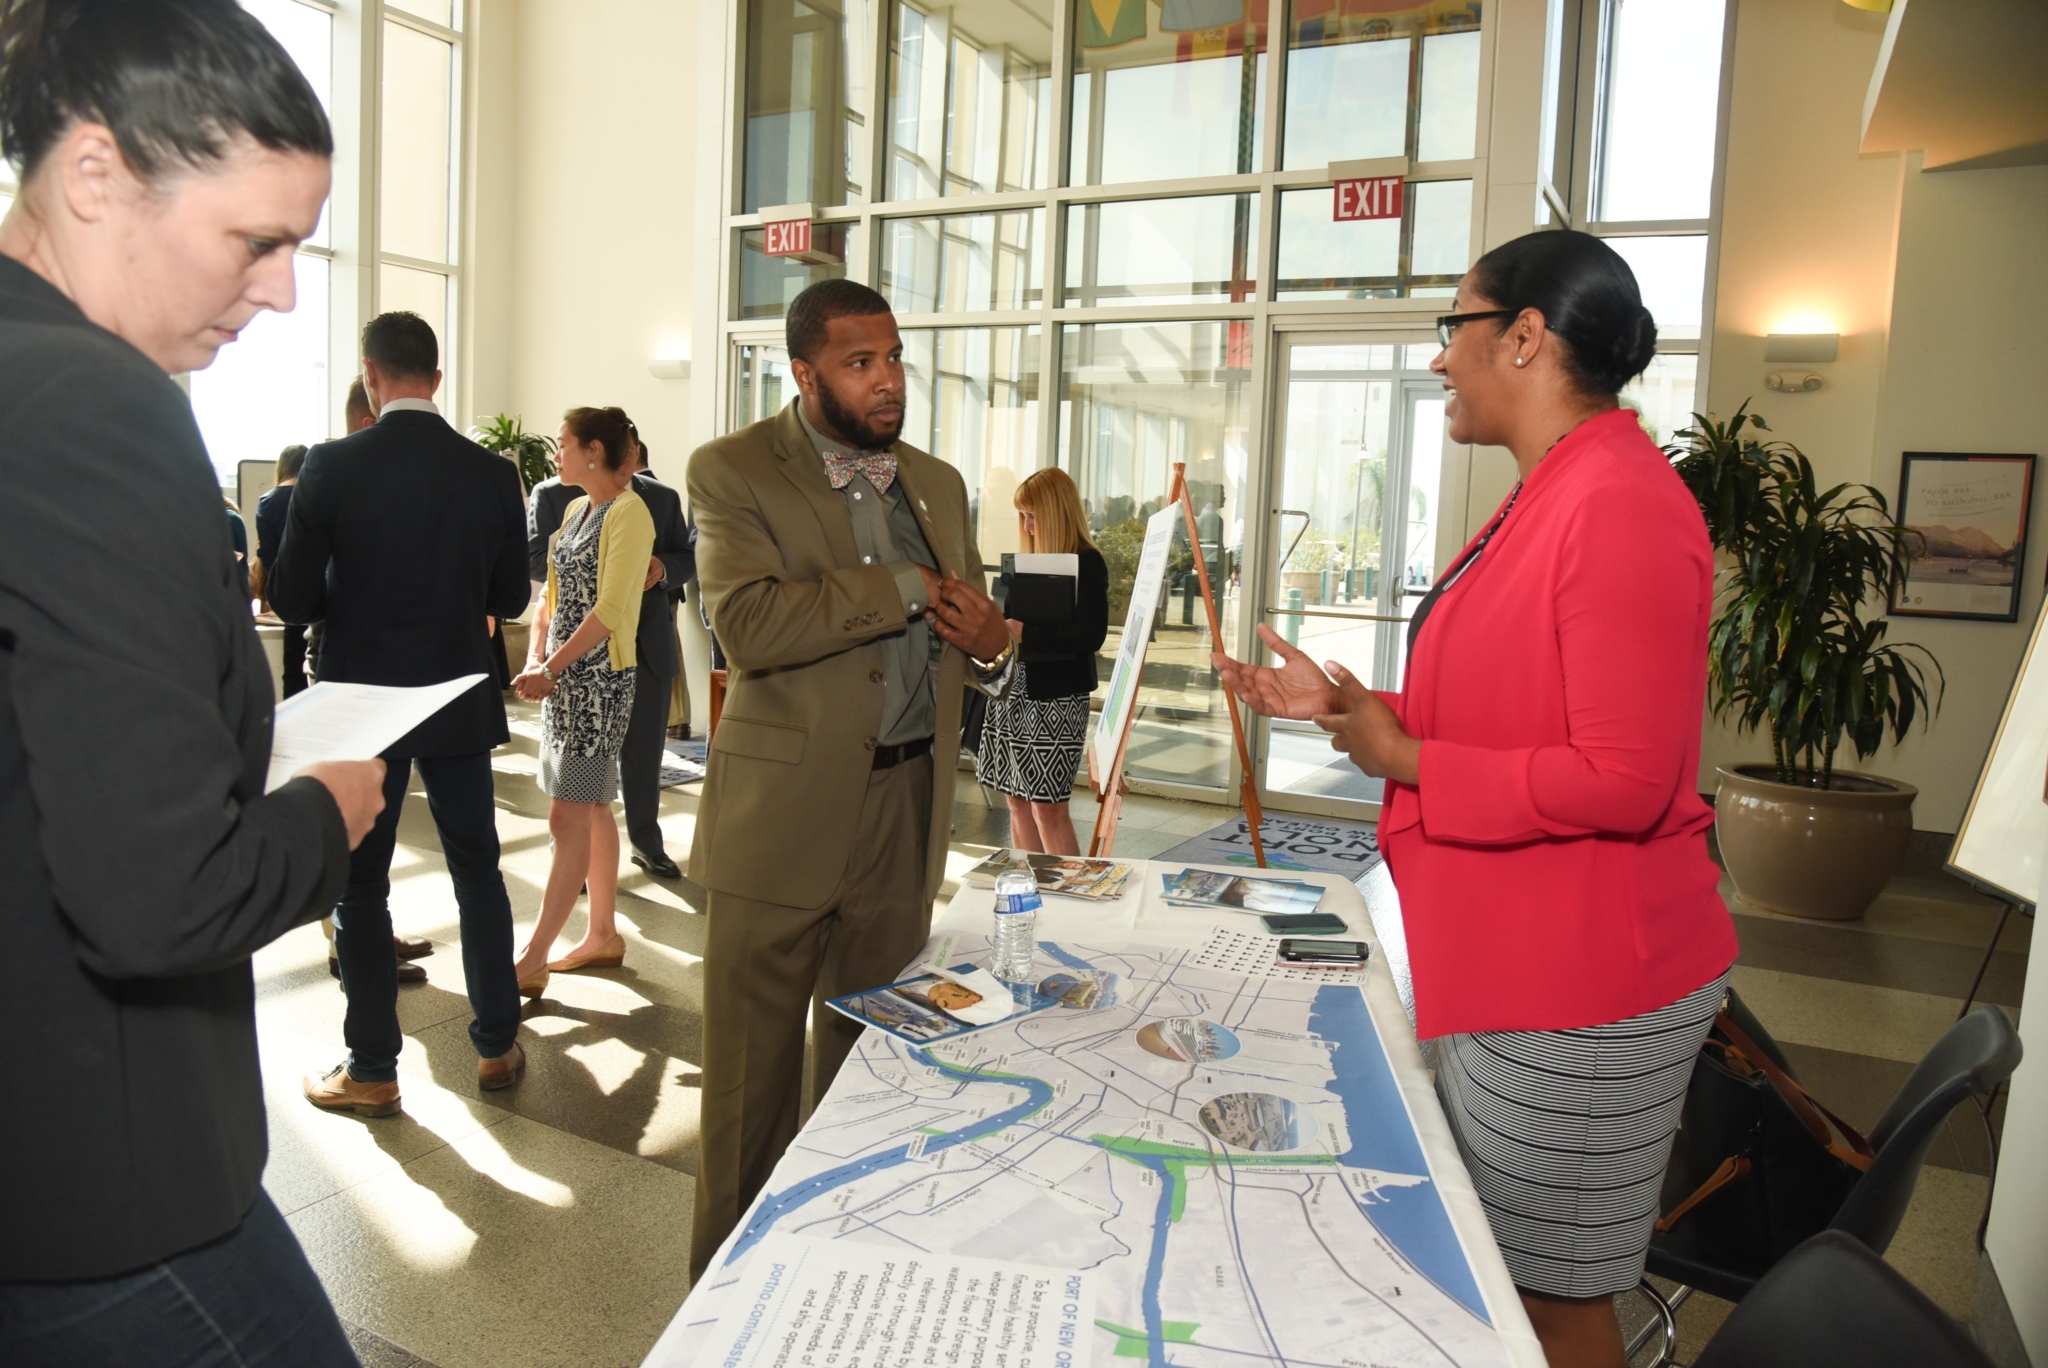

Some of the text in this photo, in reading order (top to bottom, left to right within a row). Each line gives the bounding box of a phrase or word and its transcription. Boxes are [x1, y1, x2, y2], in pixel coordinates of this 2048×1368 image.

[1338, 179, 1399, 218] EXIT
[768, 221, 807, 253] EXIT
[1920, 487, 1970, 495] FROM SEA
[1993, 491, 2012, 500] SEA
[1263, 817, 1341, 832] ORLEAN
[1209, 834, 1371, 862] PORT
[870, 1261, 896, 1310] productive
[897, 1260, 922, 1291] directly
[988, 1270, 1007, 1298] whose
[1034, 1279, 1050, 1289] To
[1064, 1274, 1081, 1301] PORT
[803, 1288, 818, 1309] and
[897, 1291, 908, 1304] or
[918, 1276, 937, 1315] relevant
[1003, 1273, 1028, 1316] financially
[1032, 1290, 1048, 1302] be
[1062, 1303, 1078, 1320] OF
[723, 1263, 787, 1368] portno.com/maste
[789, 1308, 813, 1330] ship
[800, 1269, 848, 1368] specialized needs of
[826, 1273, 869, 1364] support services to
[851, 1311, 883, 1353] facilities,
[880, 1304, 908, 1346] through
[923, 1266, 960, 1366] waterborne trade and
[945, 1278, 983, 1366] the flow of foreign
[975, 1297, 1000, 1335] primary
[1020, 1309, 1040, 1355] proactive,
[902, 1315, 923, 1356] markets
[995, 1315, 1020, 1352] healthy
[1057, 1321, 1077, 1348] NEW
